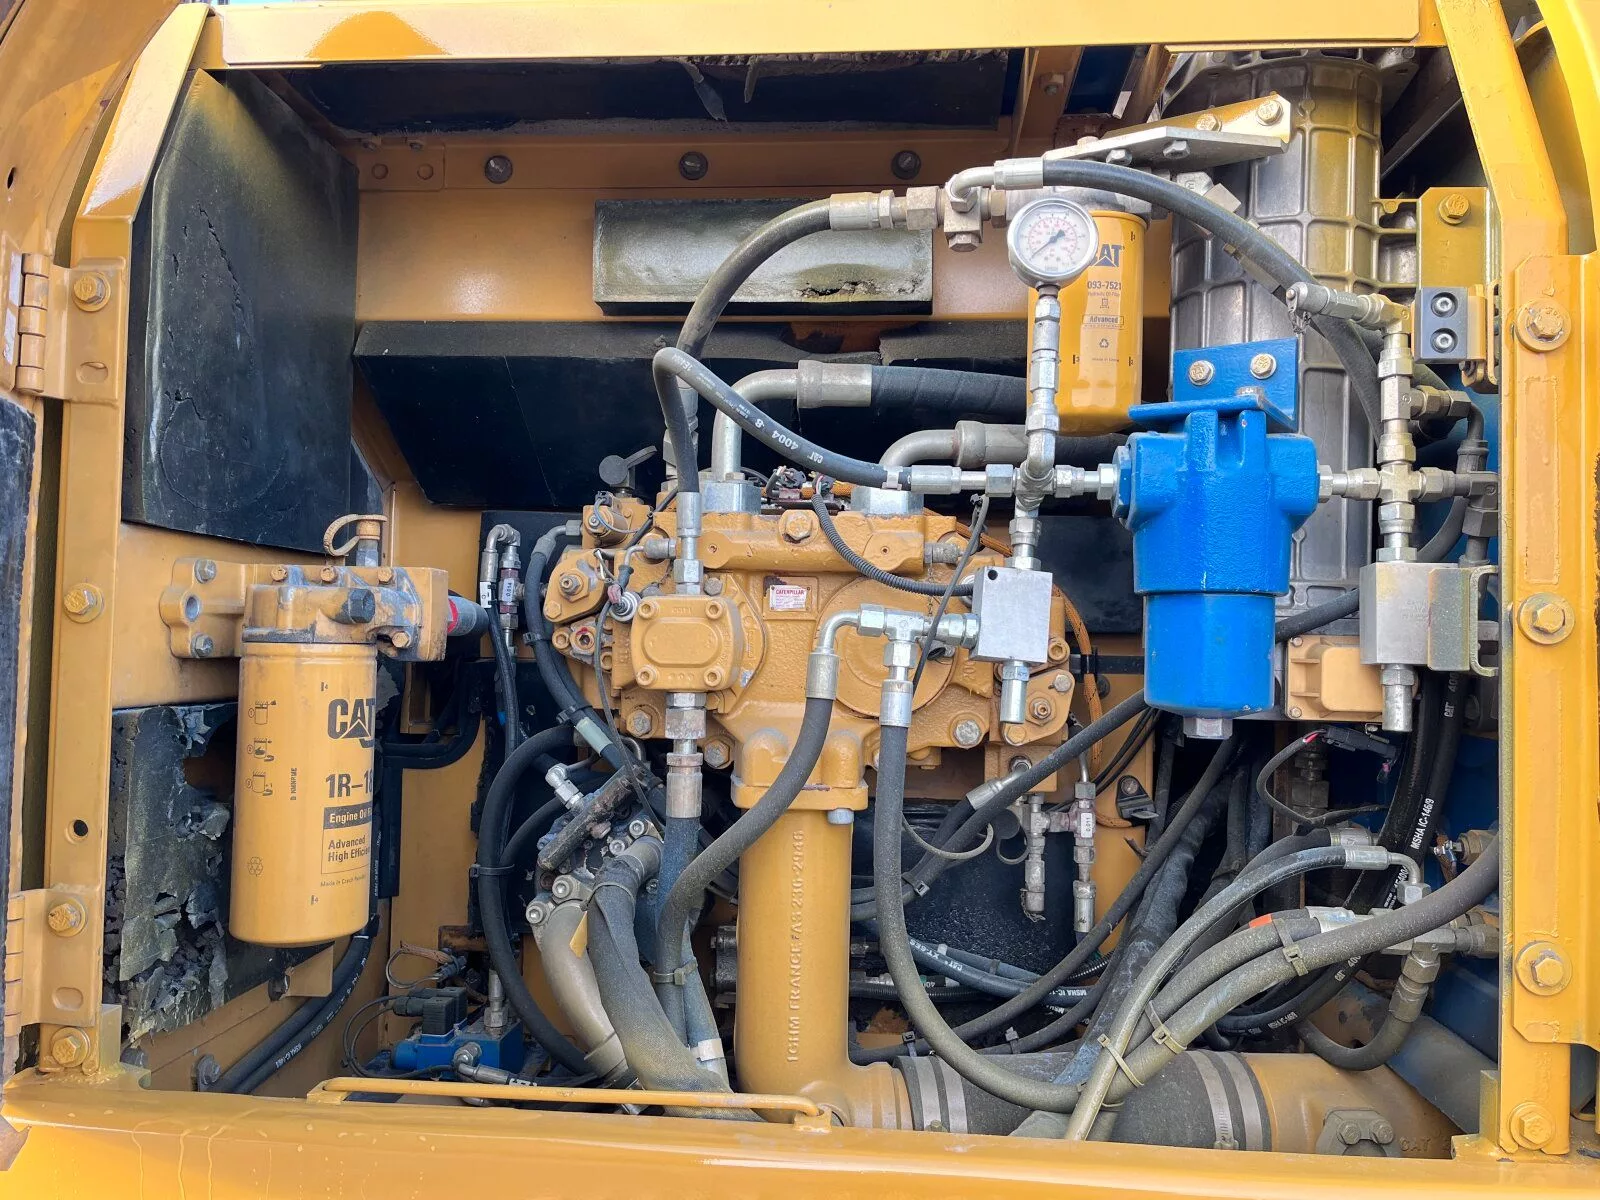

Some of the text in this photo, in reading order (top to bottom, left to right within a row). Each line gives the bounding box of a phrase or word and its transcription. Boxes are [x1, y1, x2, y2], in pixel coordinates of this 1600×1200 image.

[1091, 243, 1120, 267] AT
[1087, 281, 1121, 290] 093-7521
[771, 429, 799, 450] 4004
[808, 451, 824, 464] CAT
[327, 698, 375, 740] CAT
[329, 812, 358, 824] Engine
[359, 808, 367, 819] Oil
[328, 835, 366, 850] Advanced
[1410, 828, 1426, 850] MSHA
[328, 849, 349, 863] High
